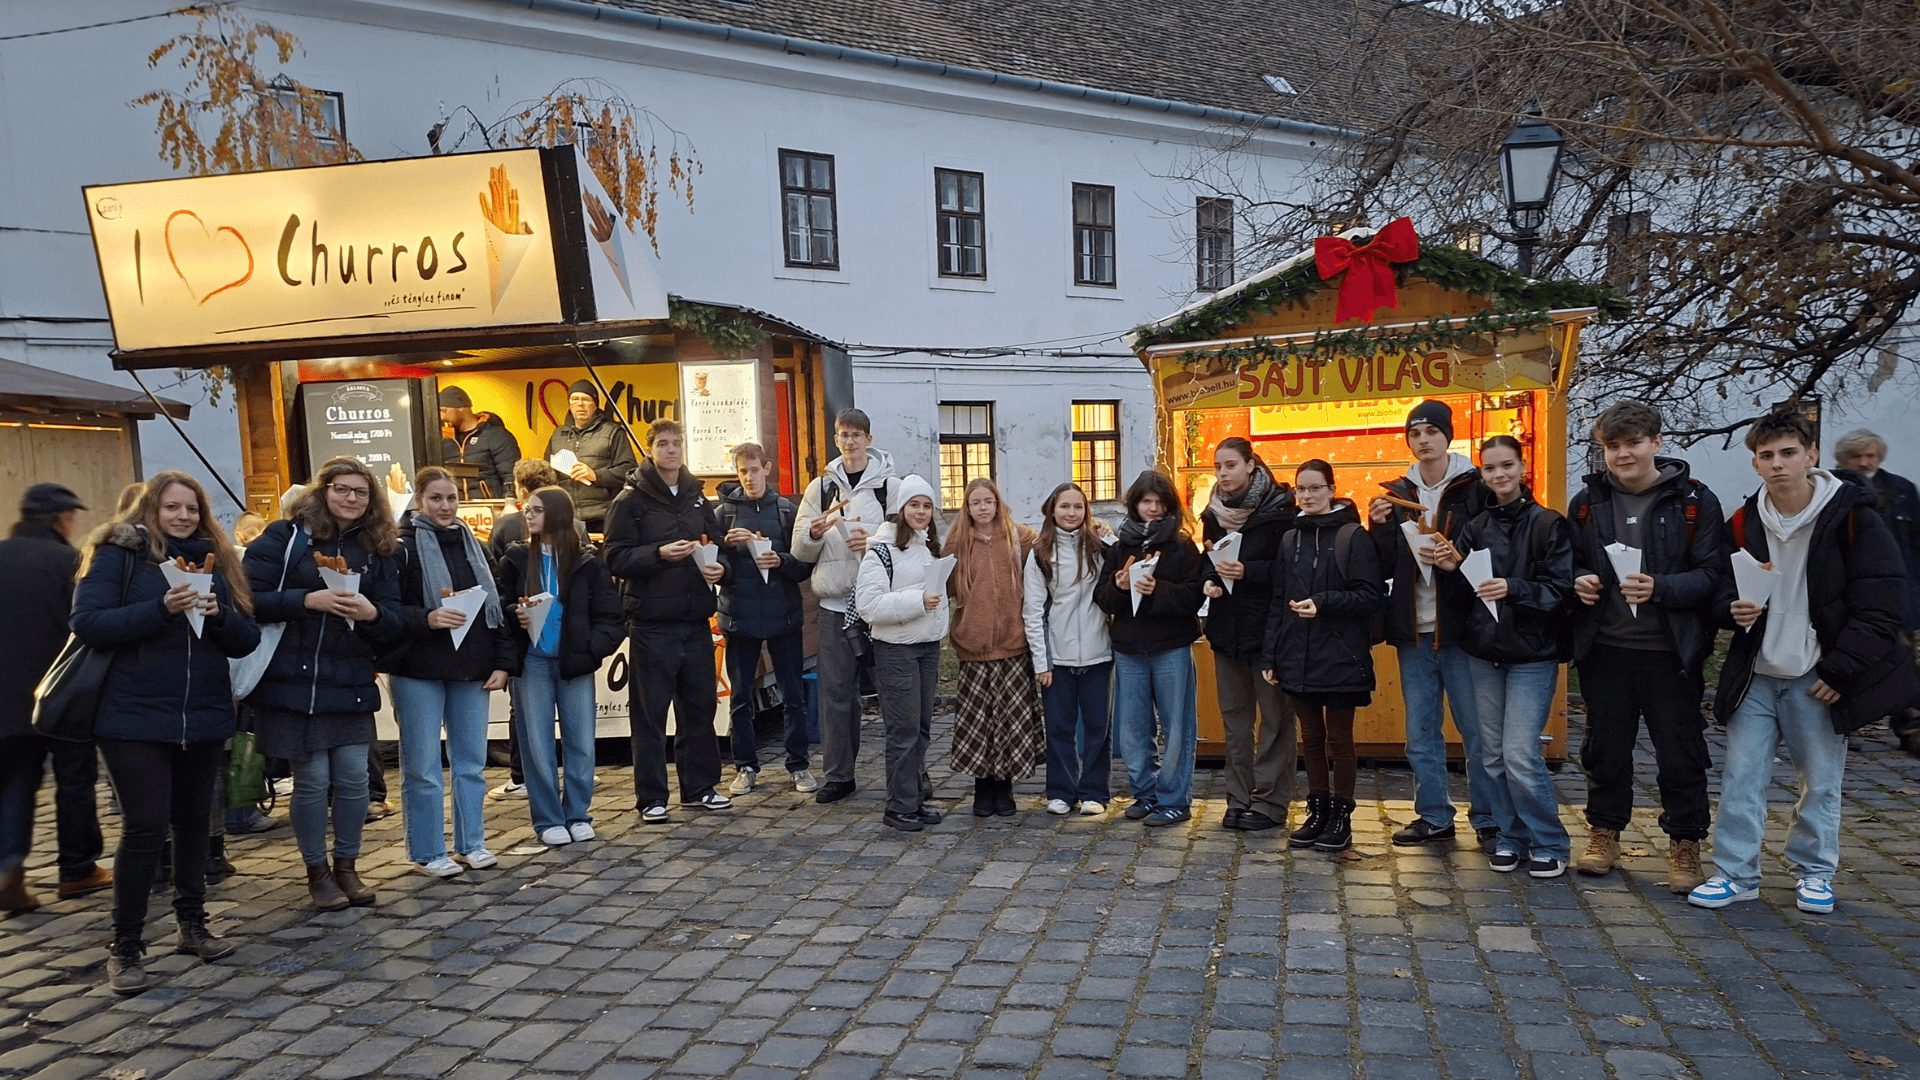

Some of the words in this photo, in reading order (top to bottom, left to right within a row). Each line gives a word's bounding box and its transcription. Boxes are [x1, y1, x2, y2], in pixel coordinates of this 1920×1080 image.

[134, 228, 144, 306] I
[277, 213, 467, 287] Churros
[1239, 360, 1326, 400] SAJT
[1166, 379, 1236, 404] www.biobell.hu
[326, 406, 391, 421] Churros
[384, 429, 393, 438] Ft
[383, 453, 391, 462] Ft
